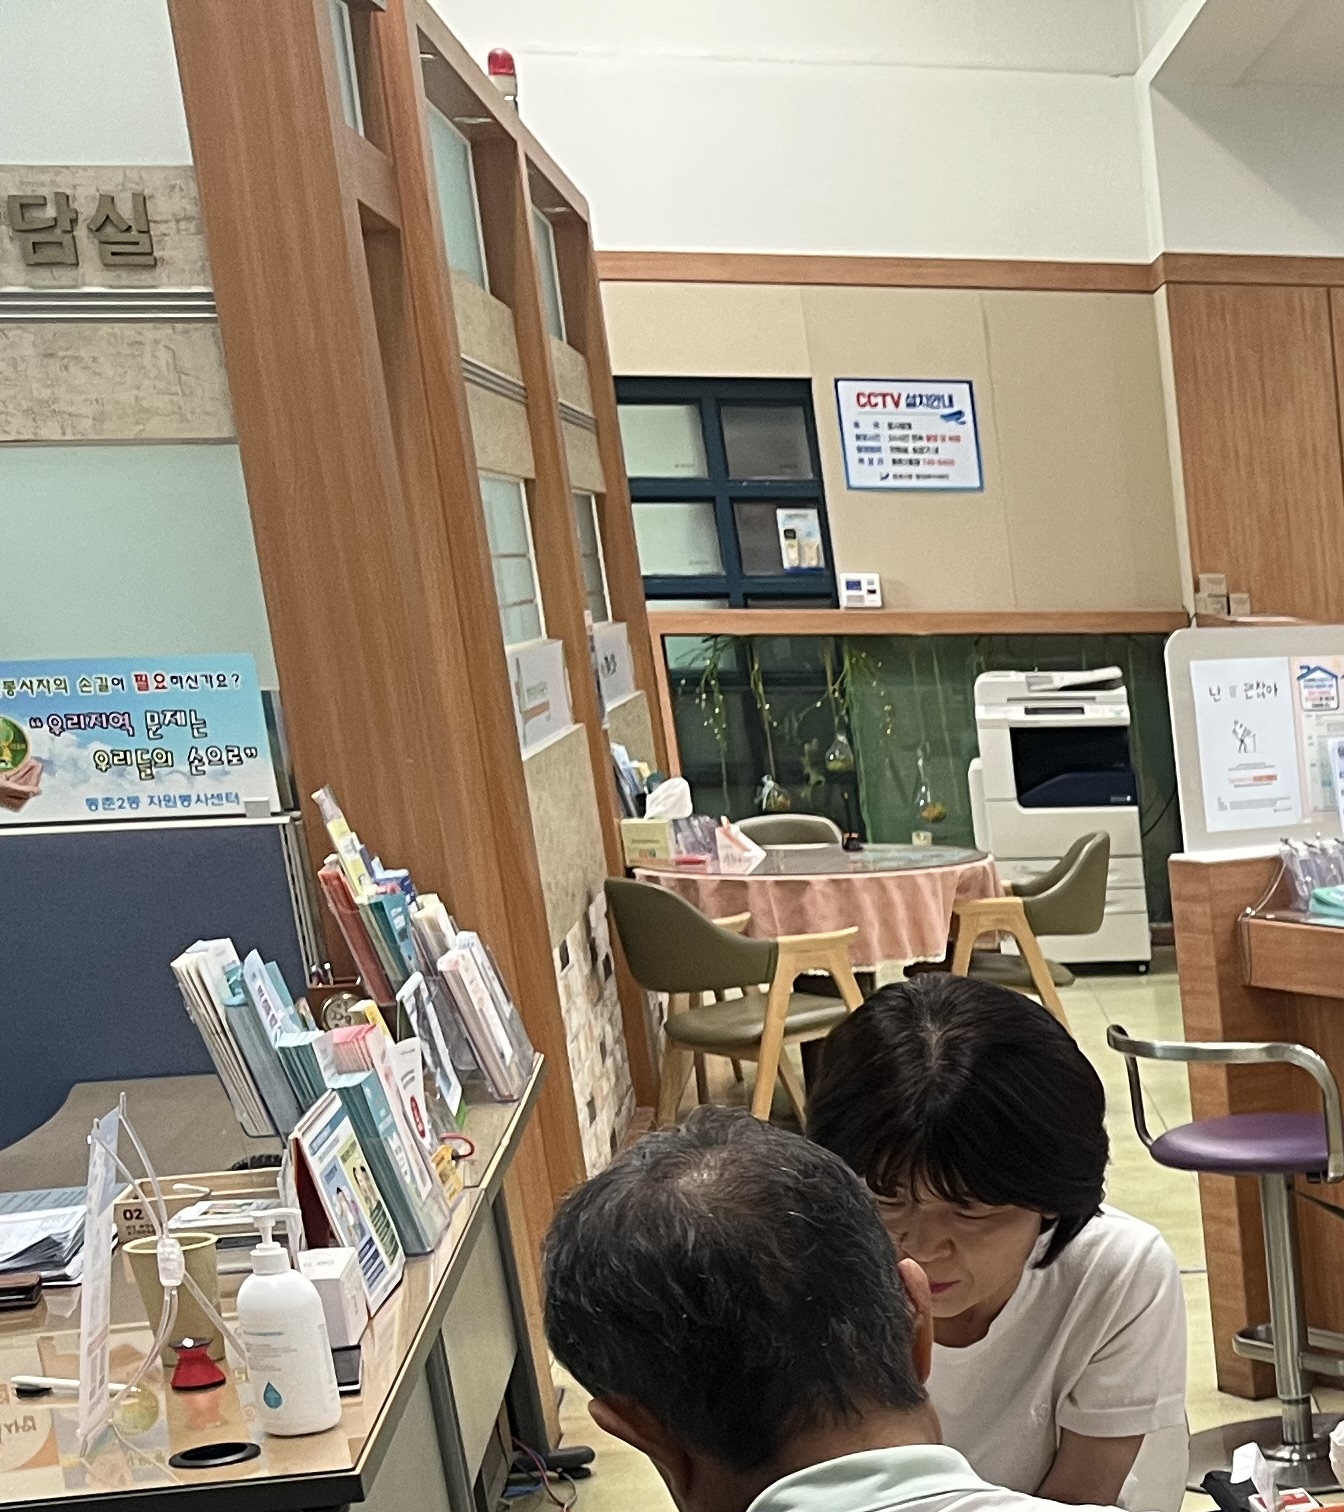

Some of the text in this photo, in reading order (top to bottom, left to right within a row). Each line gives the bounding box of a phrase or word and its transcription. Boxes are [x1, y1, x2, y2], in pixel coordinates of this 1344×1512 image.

[0, 190, 157, 267] 담실
[856, 392, 902, 409] CCTV
[78, 676, 126, 697] 손길이
[144, 709, 208, 741] 문제는
[93, 747, 174, 781] 우리들의
[85, 791, 241, 813] 동춘2동 자원봉사센터
[122, 1208, 144, 1221] 02
